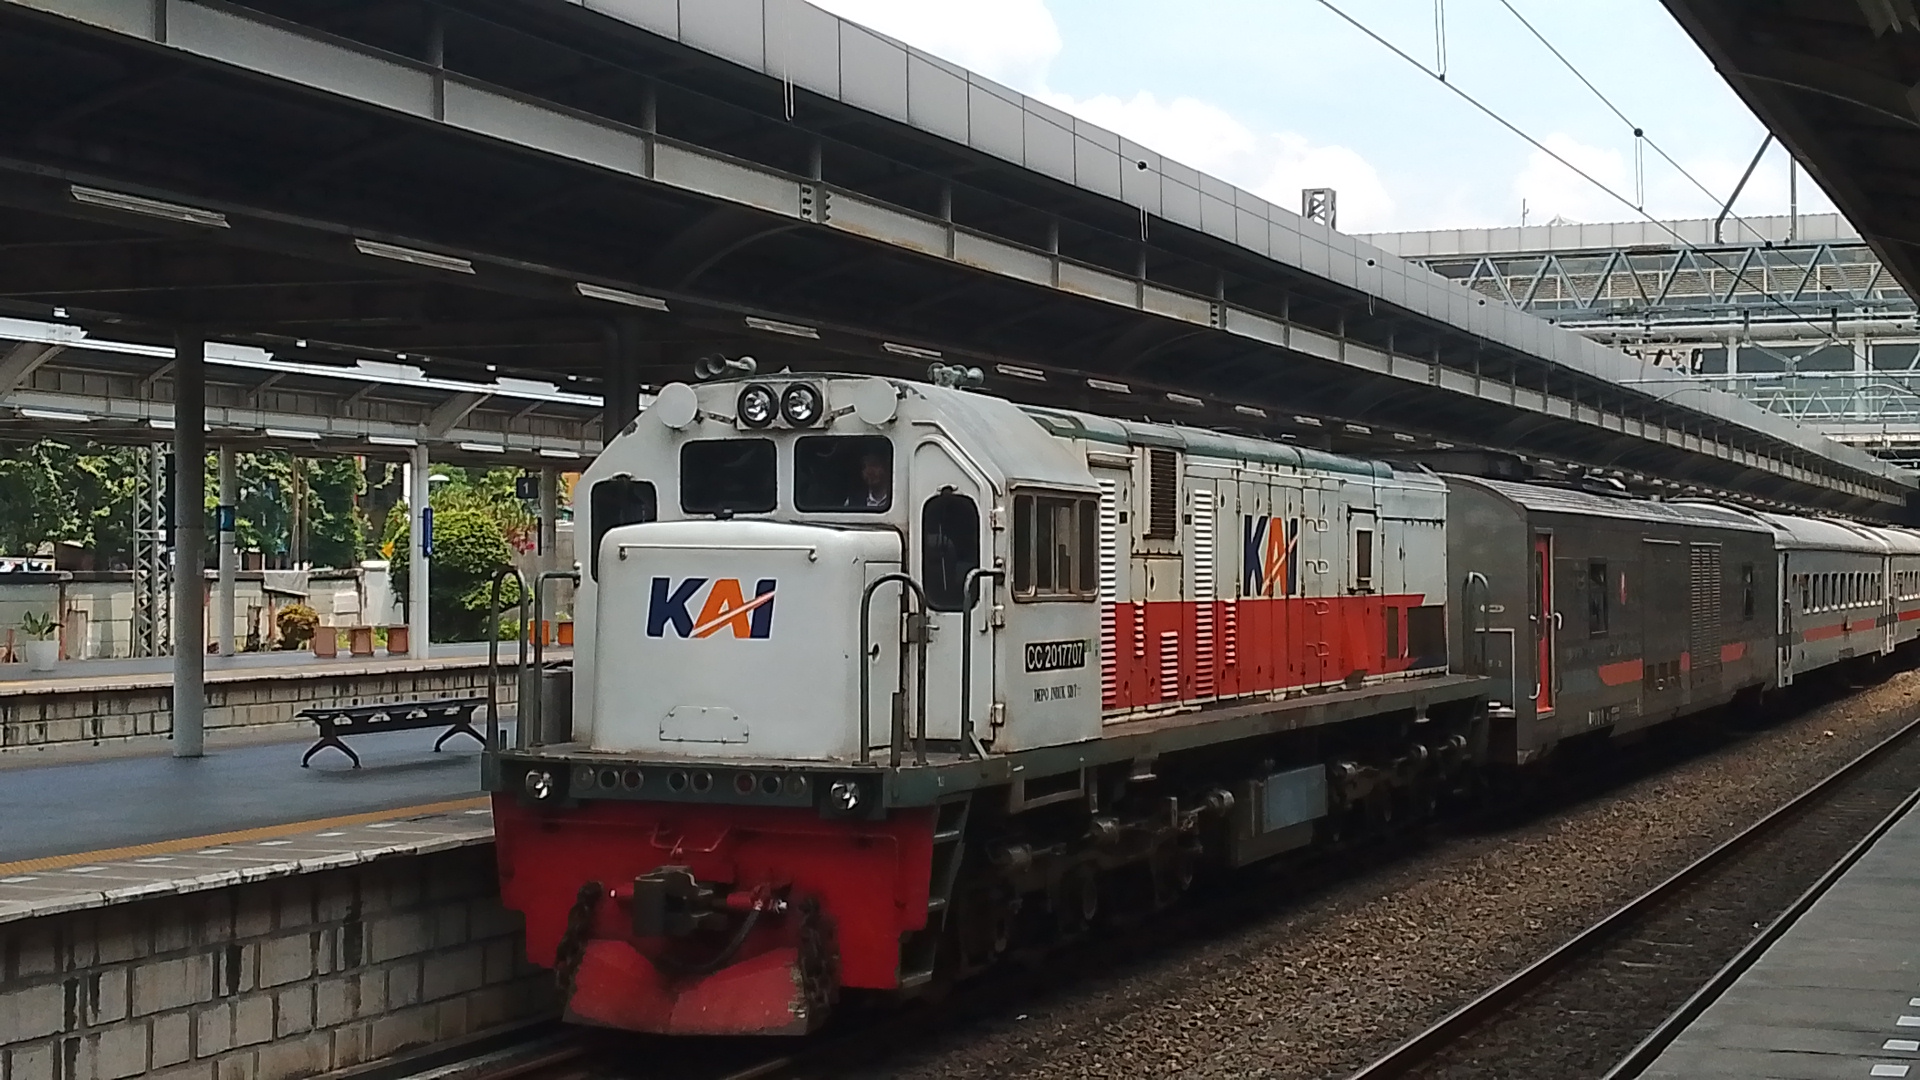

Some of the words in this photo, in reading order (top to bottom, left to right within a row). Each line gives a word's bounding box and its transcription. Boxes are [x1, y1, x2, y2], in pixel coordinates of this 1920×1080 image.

[522, 481, 529, 495] 1
[1242, 514, 1299, 597] KAI
[646, 577, 777, 640] KAI
[1027, 645, 1043, 669] CC
[1044, 642, 1083, 668] 2017707
